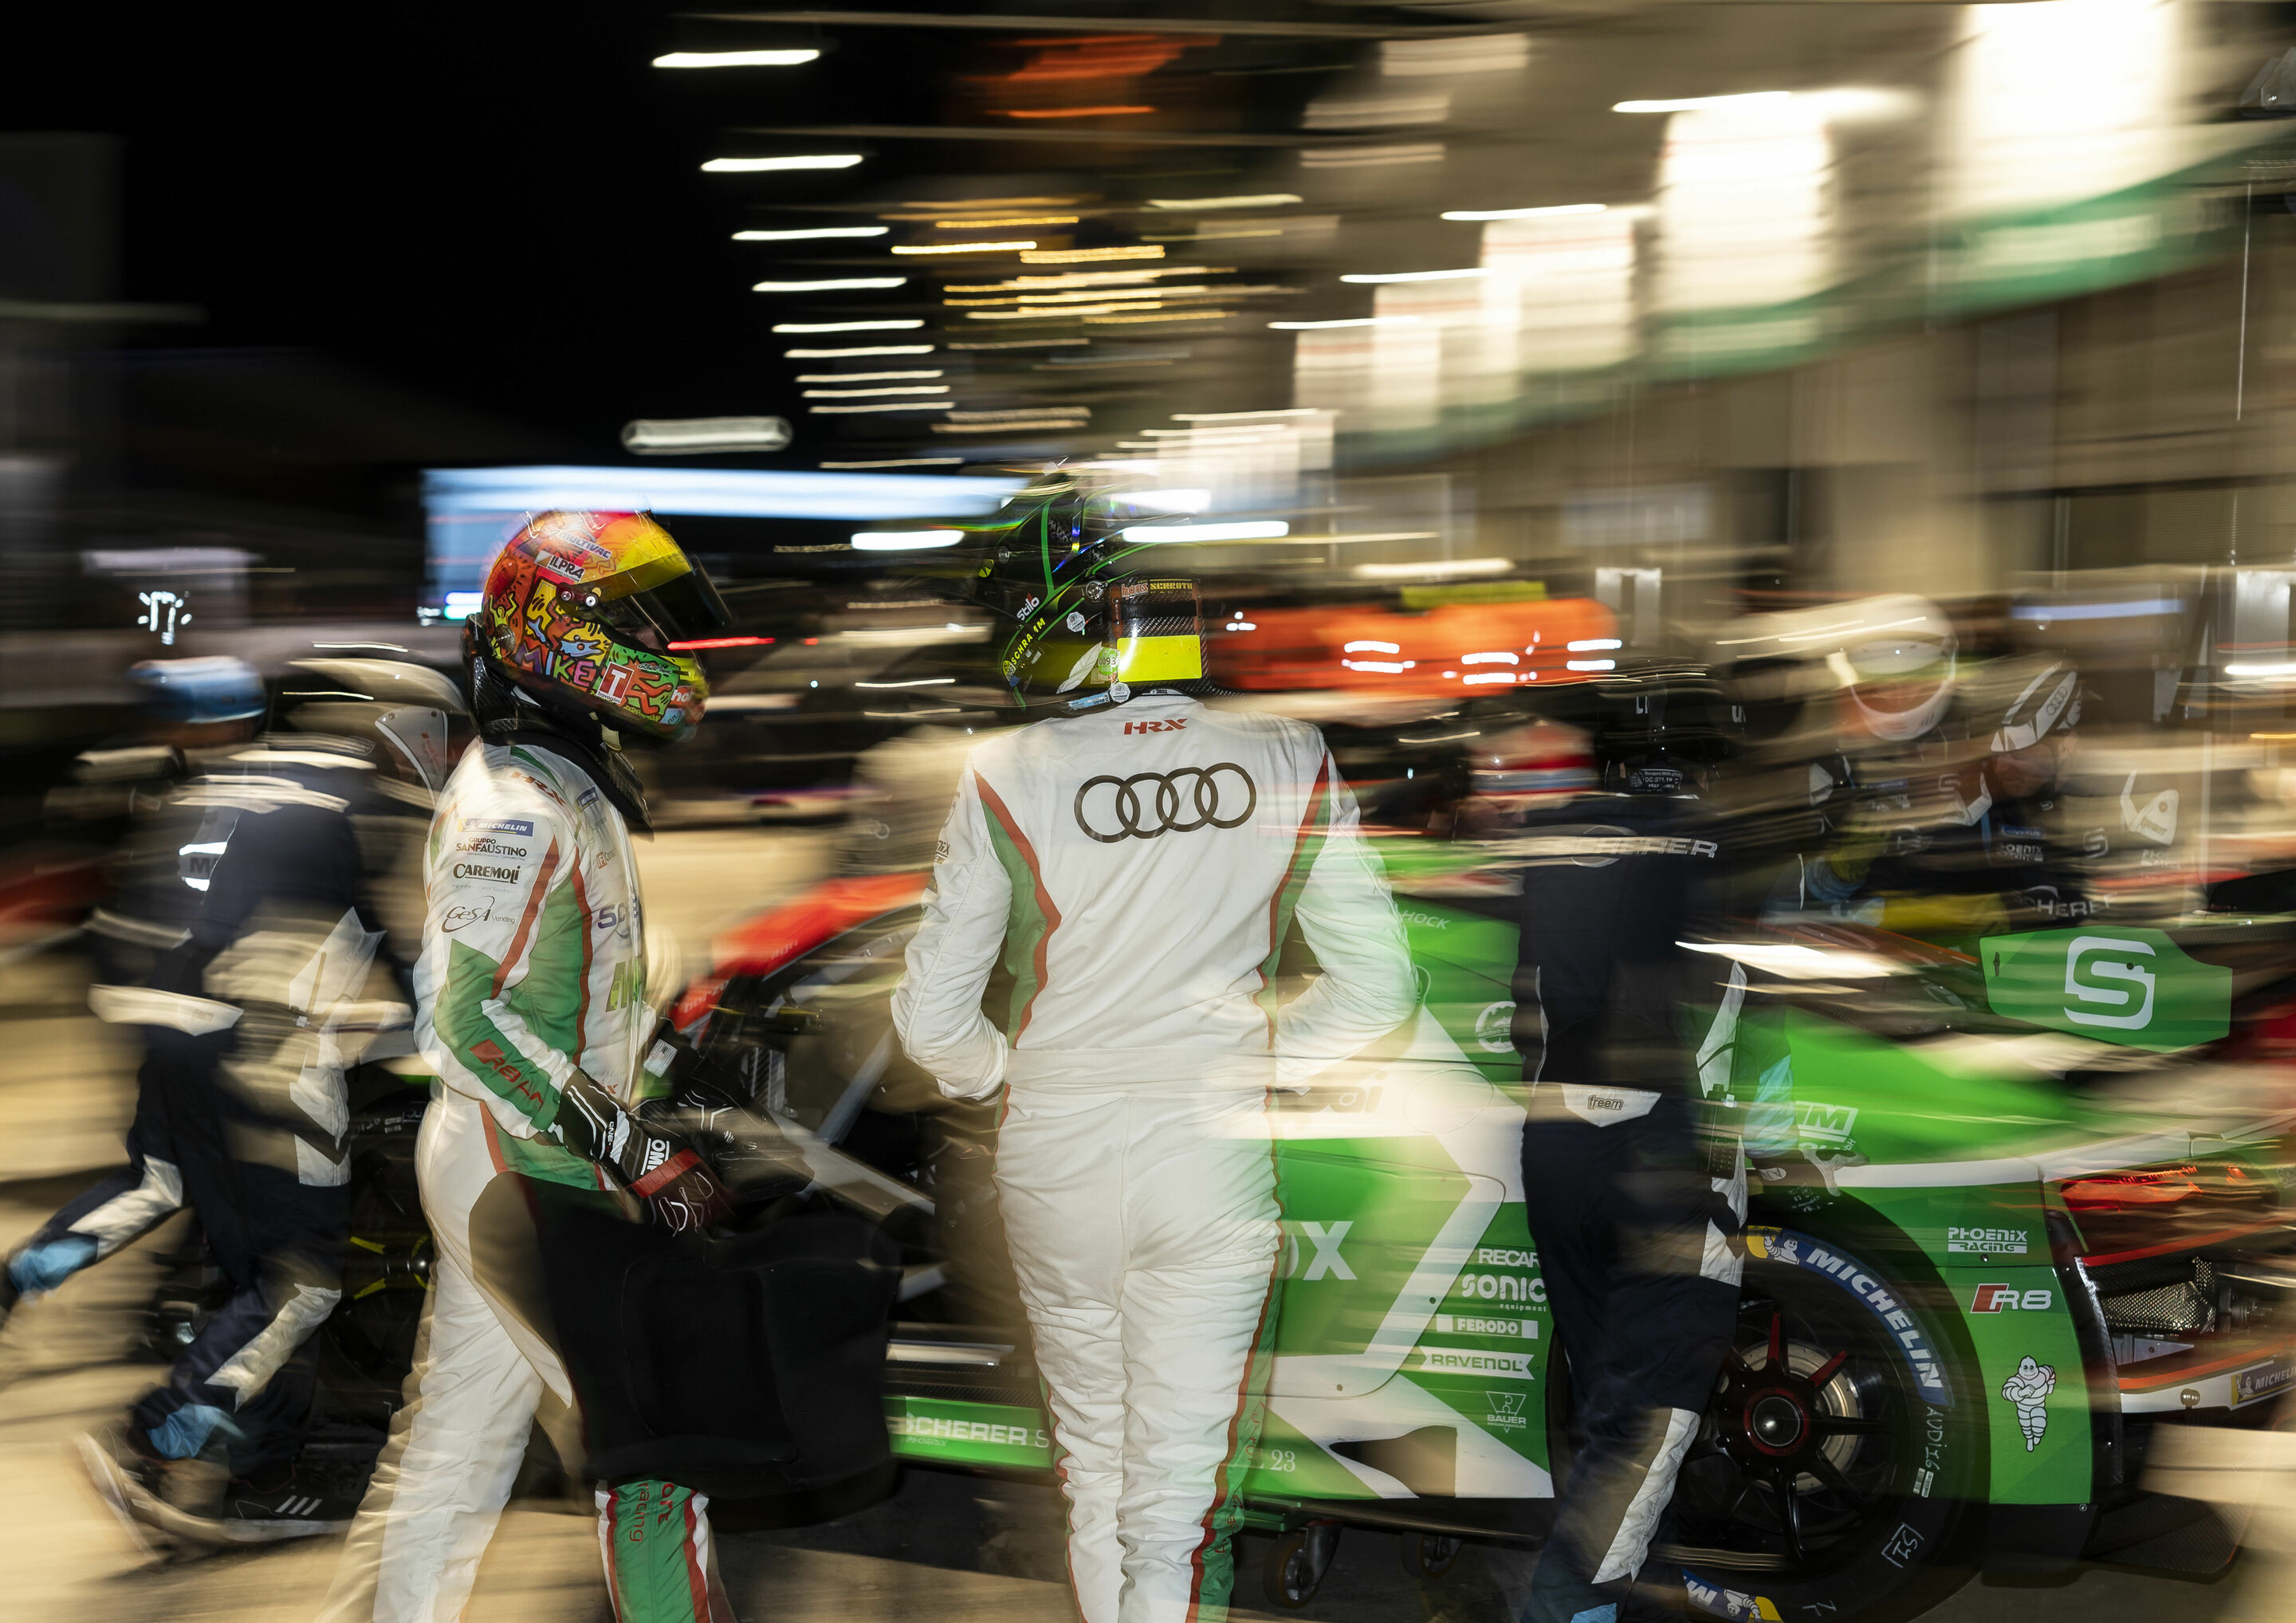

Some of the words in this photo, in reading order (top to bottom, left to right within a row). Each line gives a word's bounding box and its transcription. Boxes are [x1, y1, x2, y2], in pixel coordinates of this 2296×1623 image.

[548, 556, 585, 579] ILPRA
[1121, 582, 1148, 599] hans
[1016, 597, 1040, 621] Stilo
[514, 641, 595, 687] MIKE
[597, 690, 621, 704] Travaglini
[1124, 718, 1188, 734] HRX
[478, 822, 528, 831] MICHELIN
[456, 843, 527, 857] SANFAUSTINO
[491, 915, 515, 925] Vending
[1587, 1094, 1624, 1110] freem
[1461, 1273, 1547, 1303] SONIC
[1500, 1303, 1547, 1312] equipment
[1989, 1290, 2052, 1310] R8
[1457, 1318, 1519, 1334] FERODO
[1806, 1248, 1944, 1388] MICHELIN
[1431, 1354, 1523, 1372] RAVENOL
[1487, 1414, 1527, 1425] BAUER
[1270, 1449, 1296, 1472] 23
[629, 1483, 650, 1542] racing
